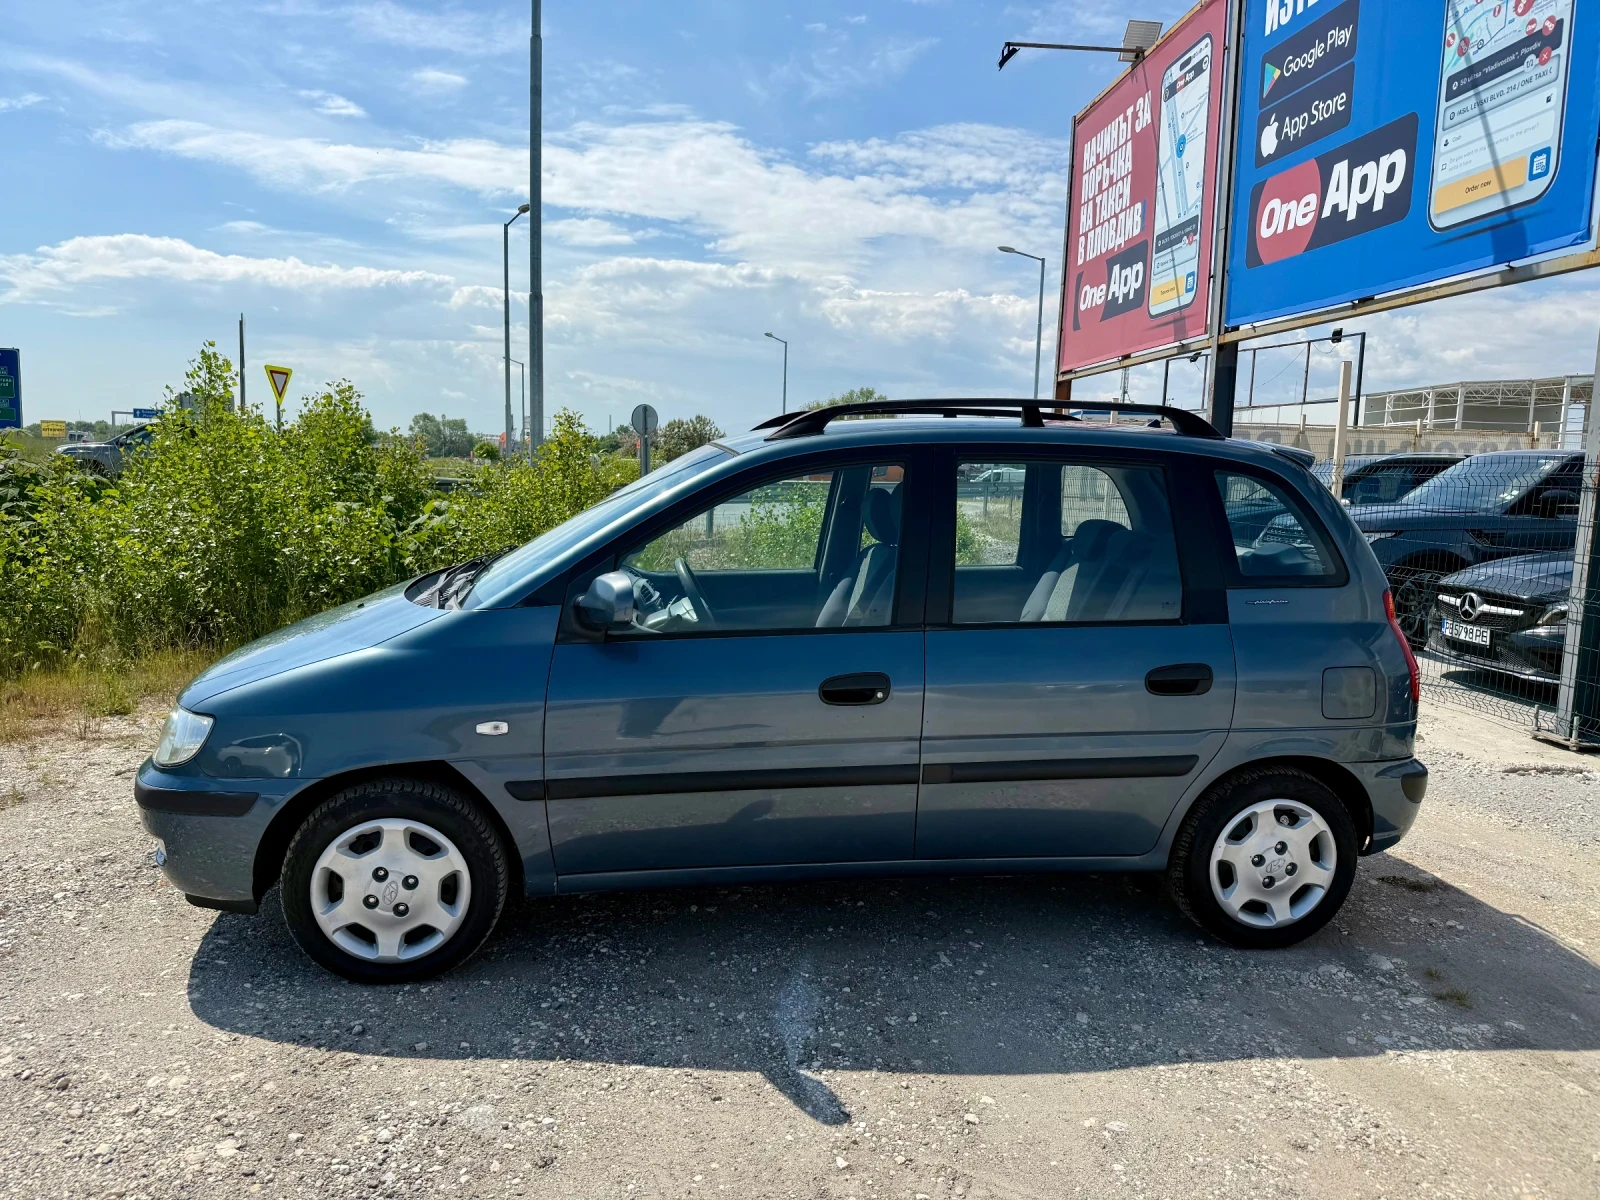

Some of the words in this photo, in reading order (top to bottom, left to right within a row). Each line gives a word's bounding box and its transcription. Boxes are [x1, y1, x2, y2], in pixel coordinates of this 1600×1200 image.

[1283, 39, 1325, 77] Google
[1326, 24, 1353, 53] Play
[1470, 97, 1490, 111] LEVSKI
[1506, 84, 1516, 94] 214
[1520, 76, 1533, 87] ONE
[1534, 69, 1548, 81] TAXI
[1083, 105, 1134, 174] НАЧИНЪТ
[1135, 90, 1152, 133] ЗА
[1281, 116, 1309, 141] App
[1310, 92, 1347, 126] Store
[1081, 139, 1133, 205] ПОРЪЧКА
[1260, 193, 1318, 239] One
[1321, 148, 1407, 222] App
[1464, 183, 1480, 194] Order
[1480, 179, 1492, 189] now
[1079, 200, 1093, 235] НА
[1095, 173, 1132, 226] ТАКСИ
[1077, 235, 1085, 266] В
[1079, 282, 1107, 311] One
[1107, 261, 1144, 304] App
